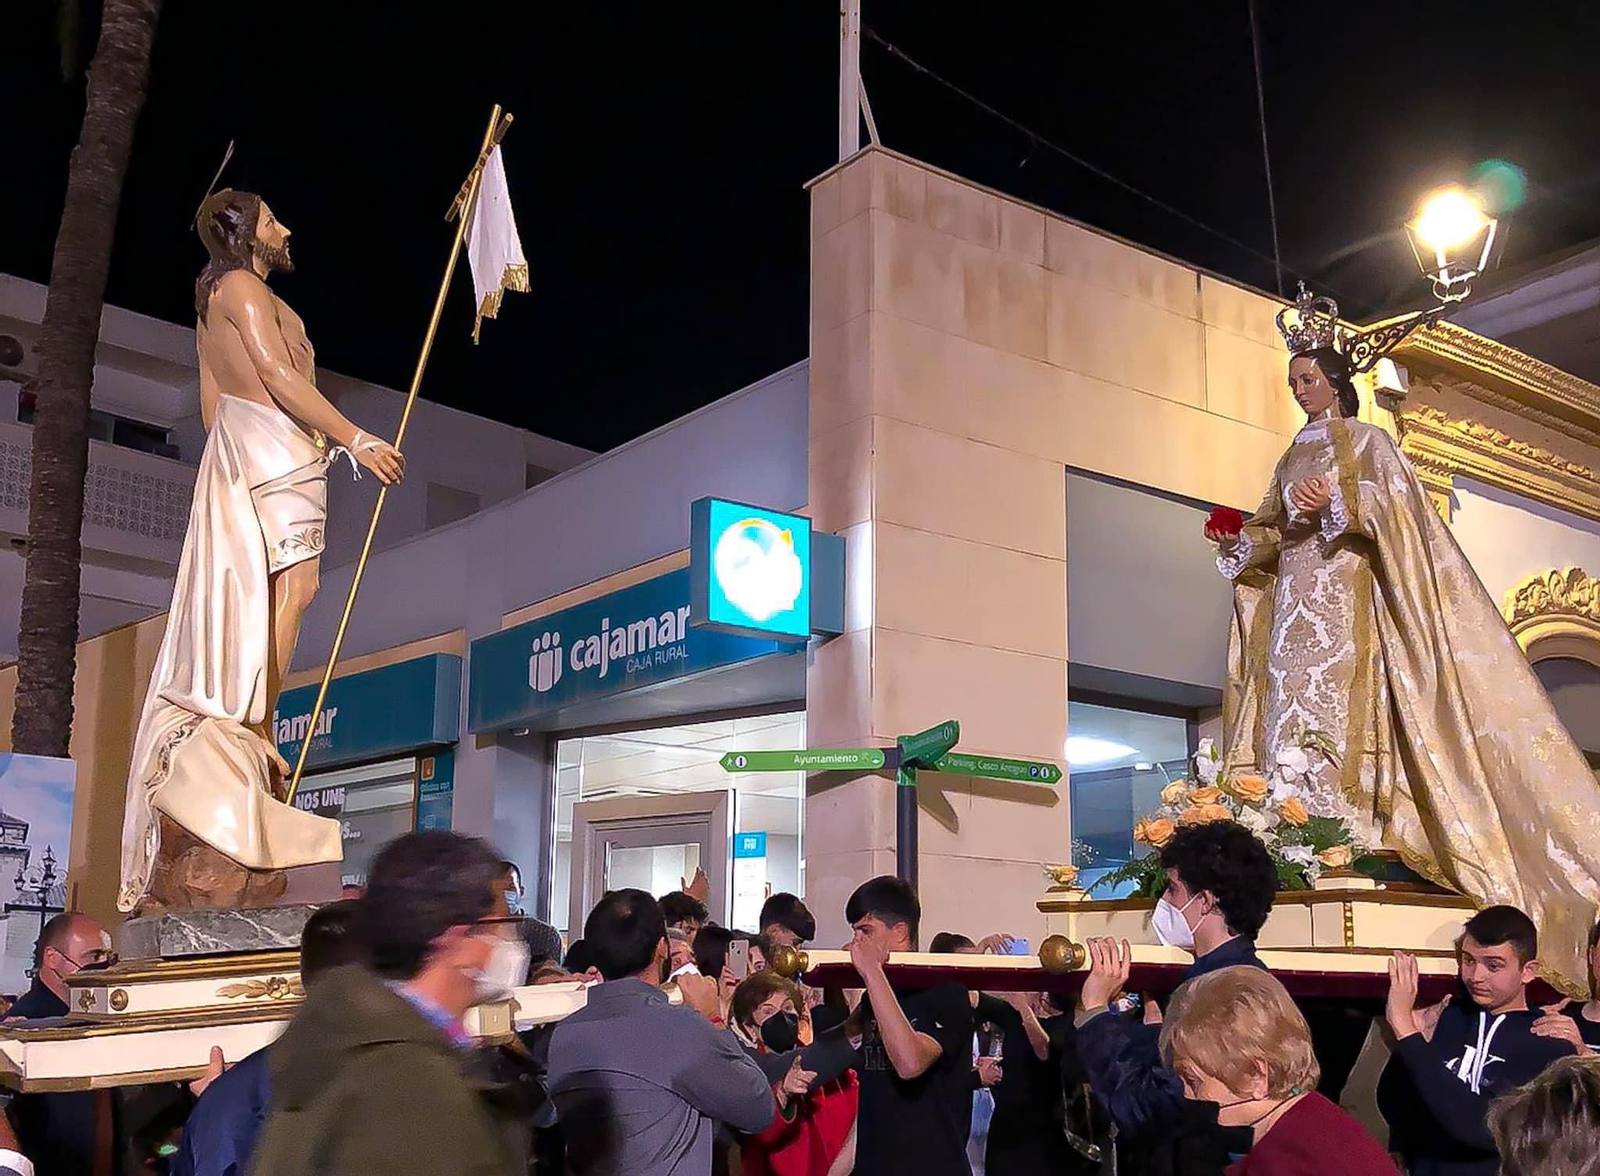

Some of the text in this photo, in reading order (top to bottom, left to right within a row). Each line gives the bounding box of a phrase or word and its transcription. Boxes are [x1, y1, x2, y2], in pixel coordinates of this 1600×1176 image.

[570, 604, 691, 679] cajamar
[626, 643, 689, 673] CAJA RURAL
[273, 706, 338, 749] jamar
[793, 754, 858, 766] Ayuntamiento
[295, 787, 346, 810] NOS UNE
